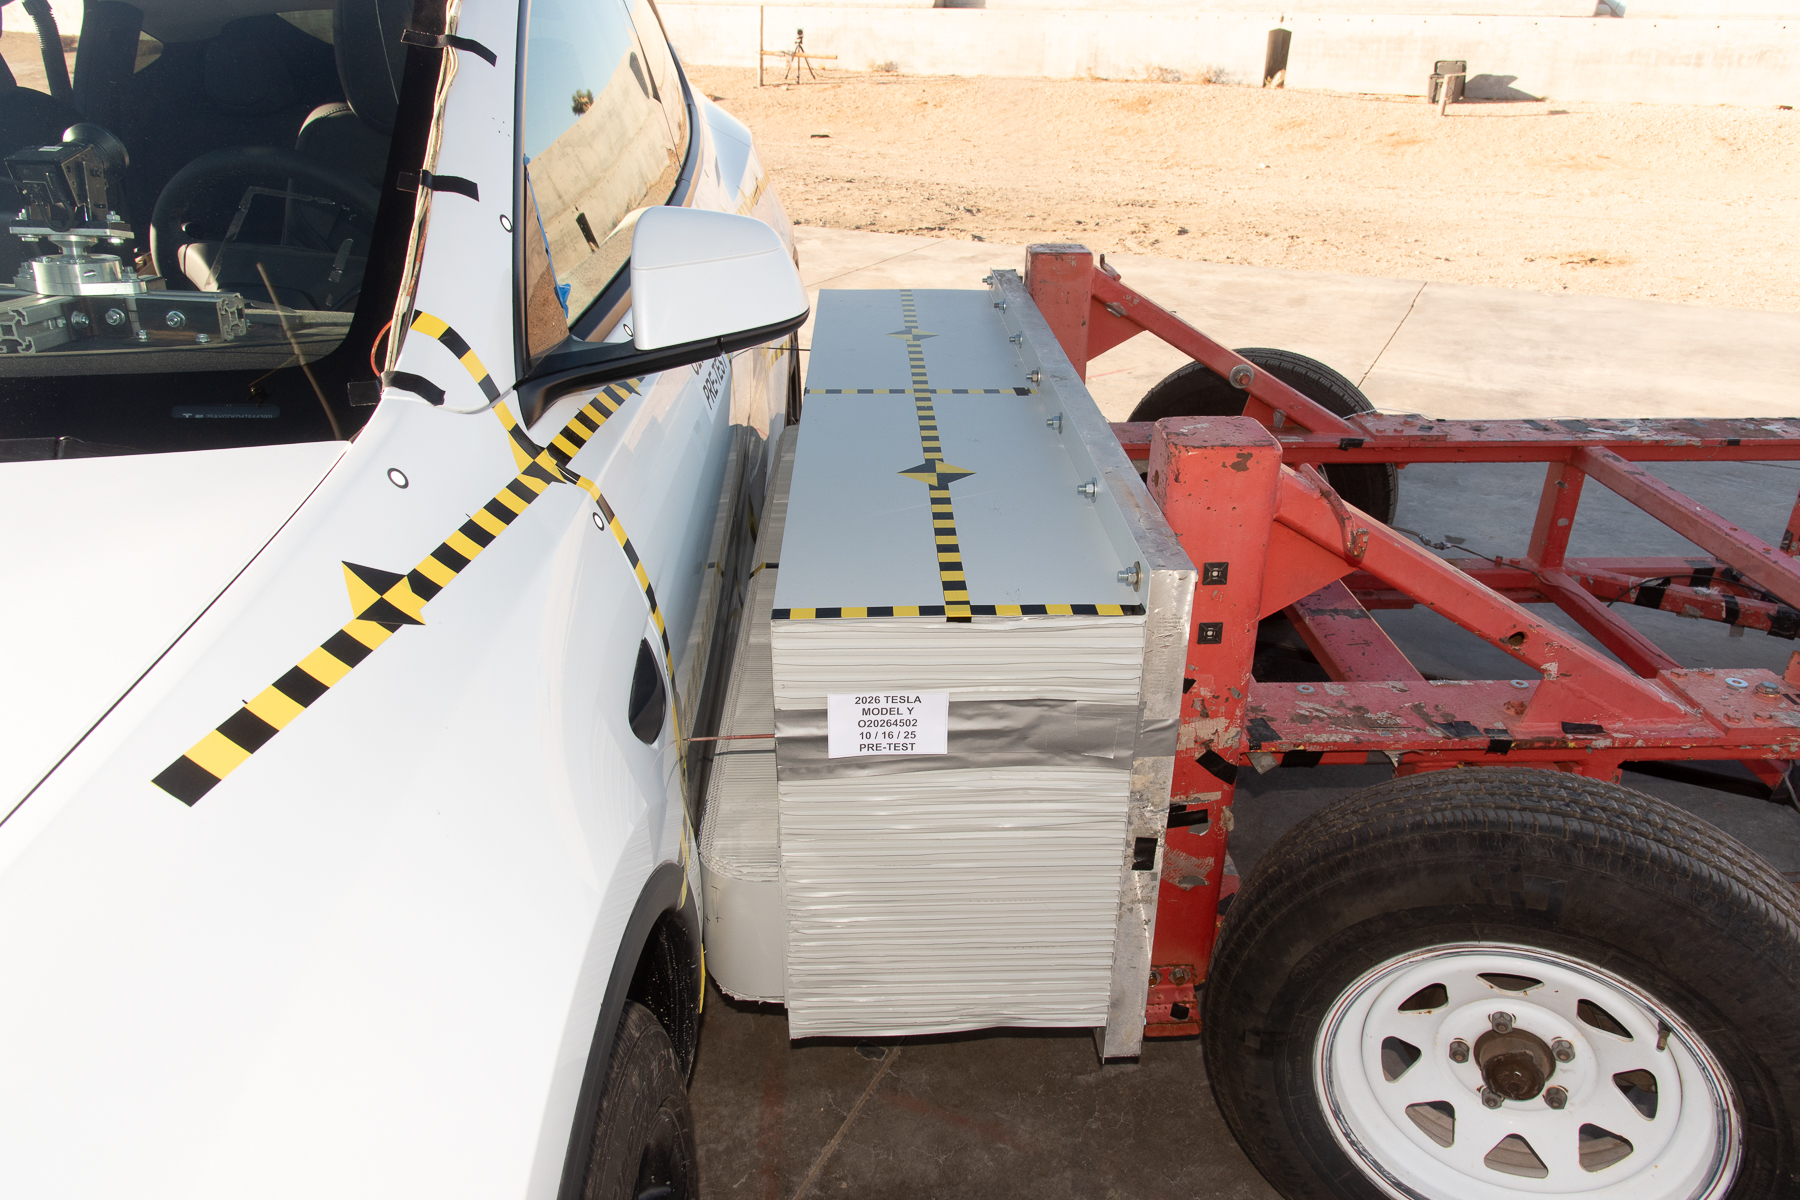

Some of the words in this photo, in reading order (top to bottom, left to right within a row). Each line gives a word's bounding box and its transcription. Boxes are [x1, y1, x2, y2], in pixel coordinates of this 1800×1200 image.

[855, 696, 881, 704] 2026
[884, 695, 921, 704] TESLA
[862, 708, 903, 716] MODEL
[907, 707, 914, 715] Y
[859, 743, 915, 752] PRE-TEST
